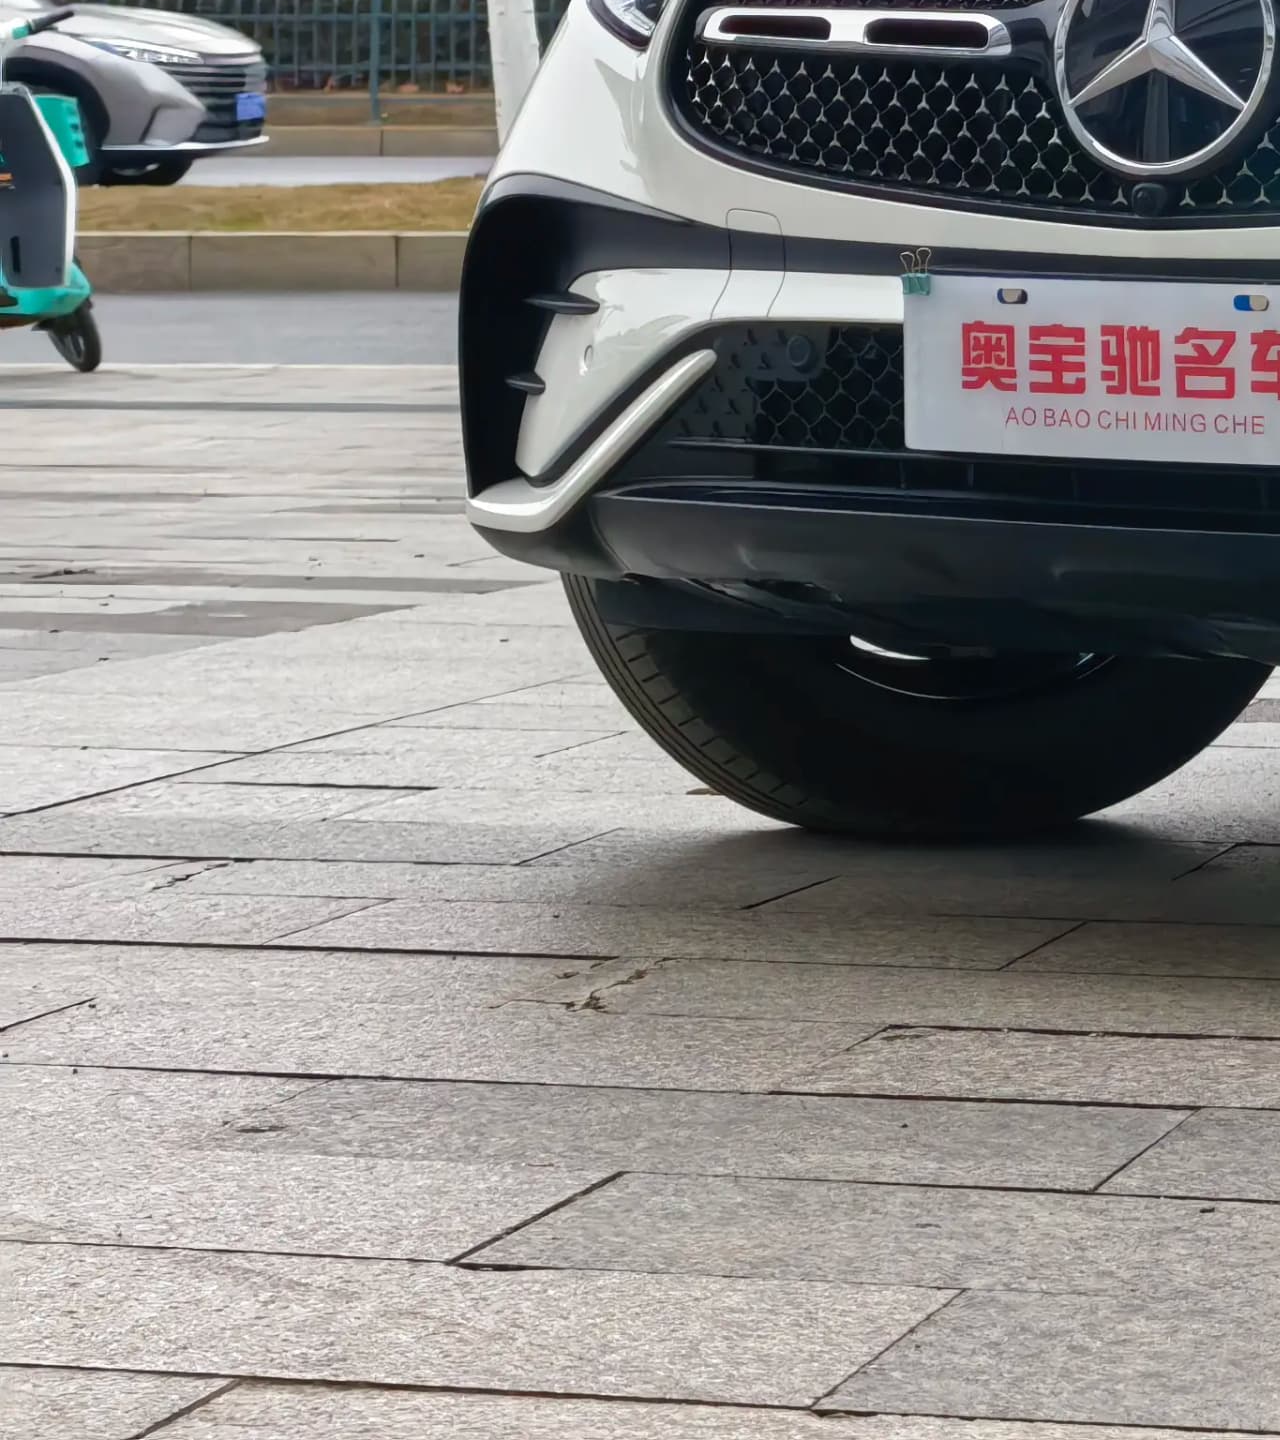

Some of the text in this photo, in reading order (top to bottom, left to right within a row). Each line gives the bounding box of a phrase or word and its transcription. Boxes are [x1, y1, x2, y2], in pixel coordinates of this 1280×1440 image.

[1005, 407, 1265, 435] AO BAO CHI MING CHE
